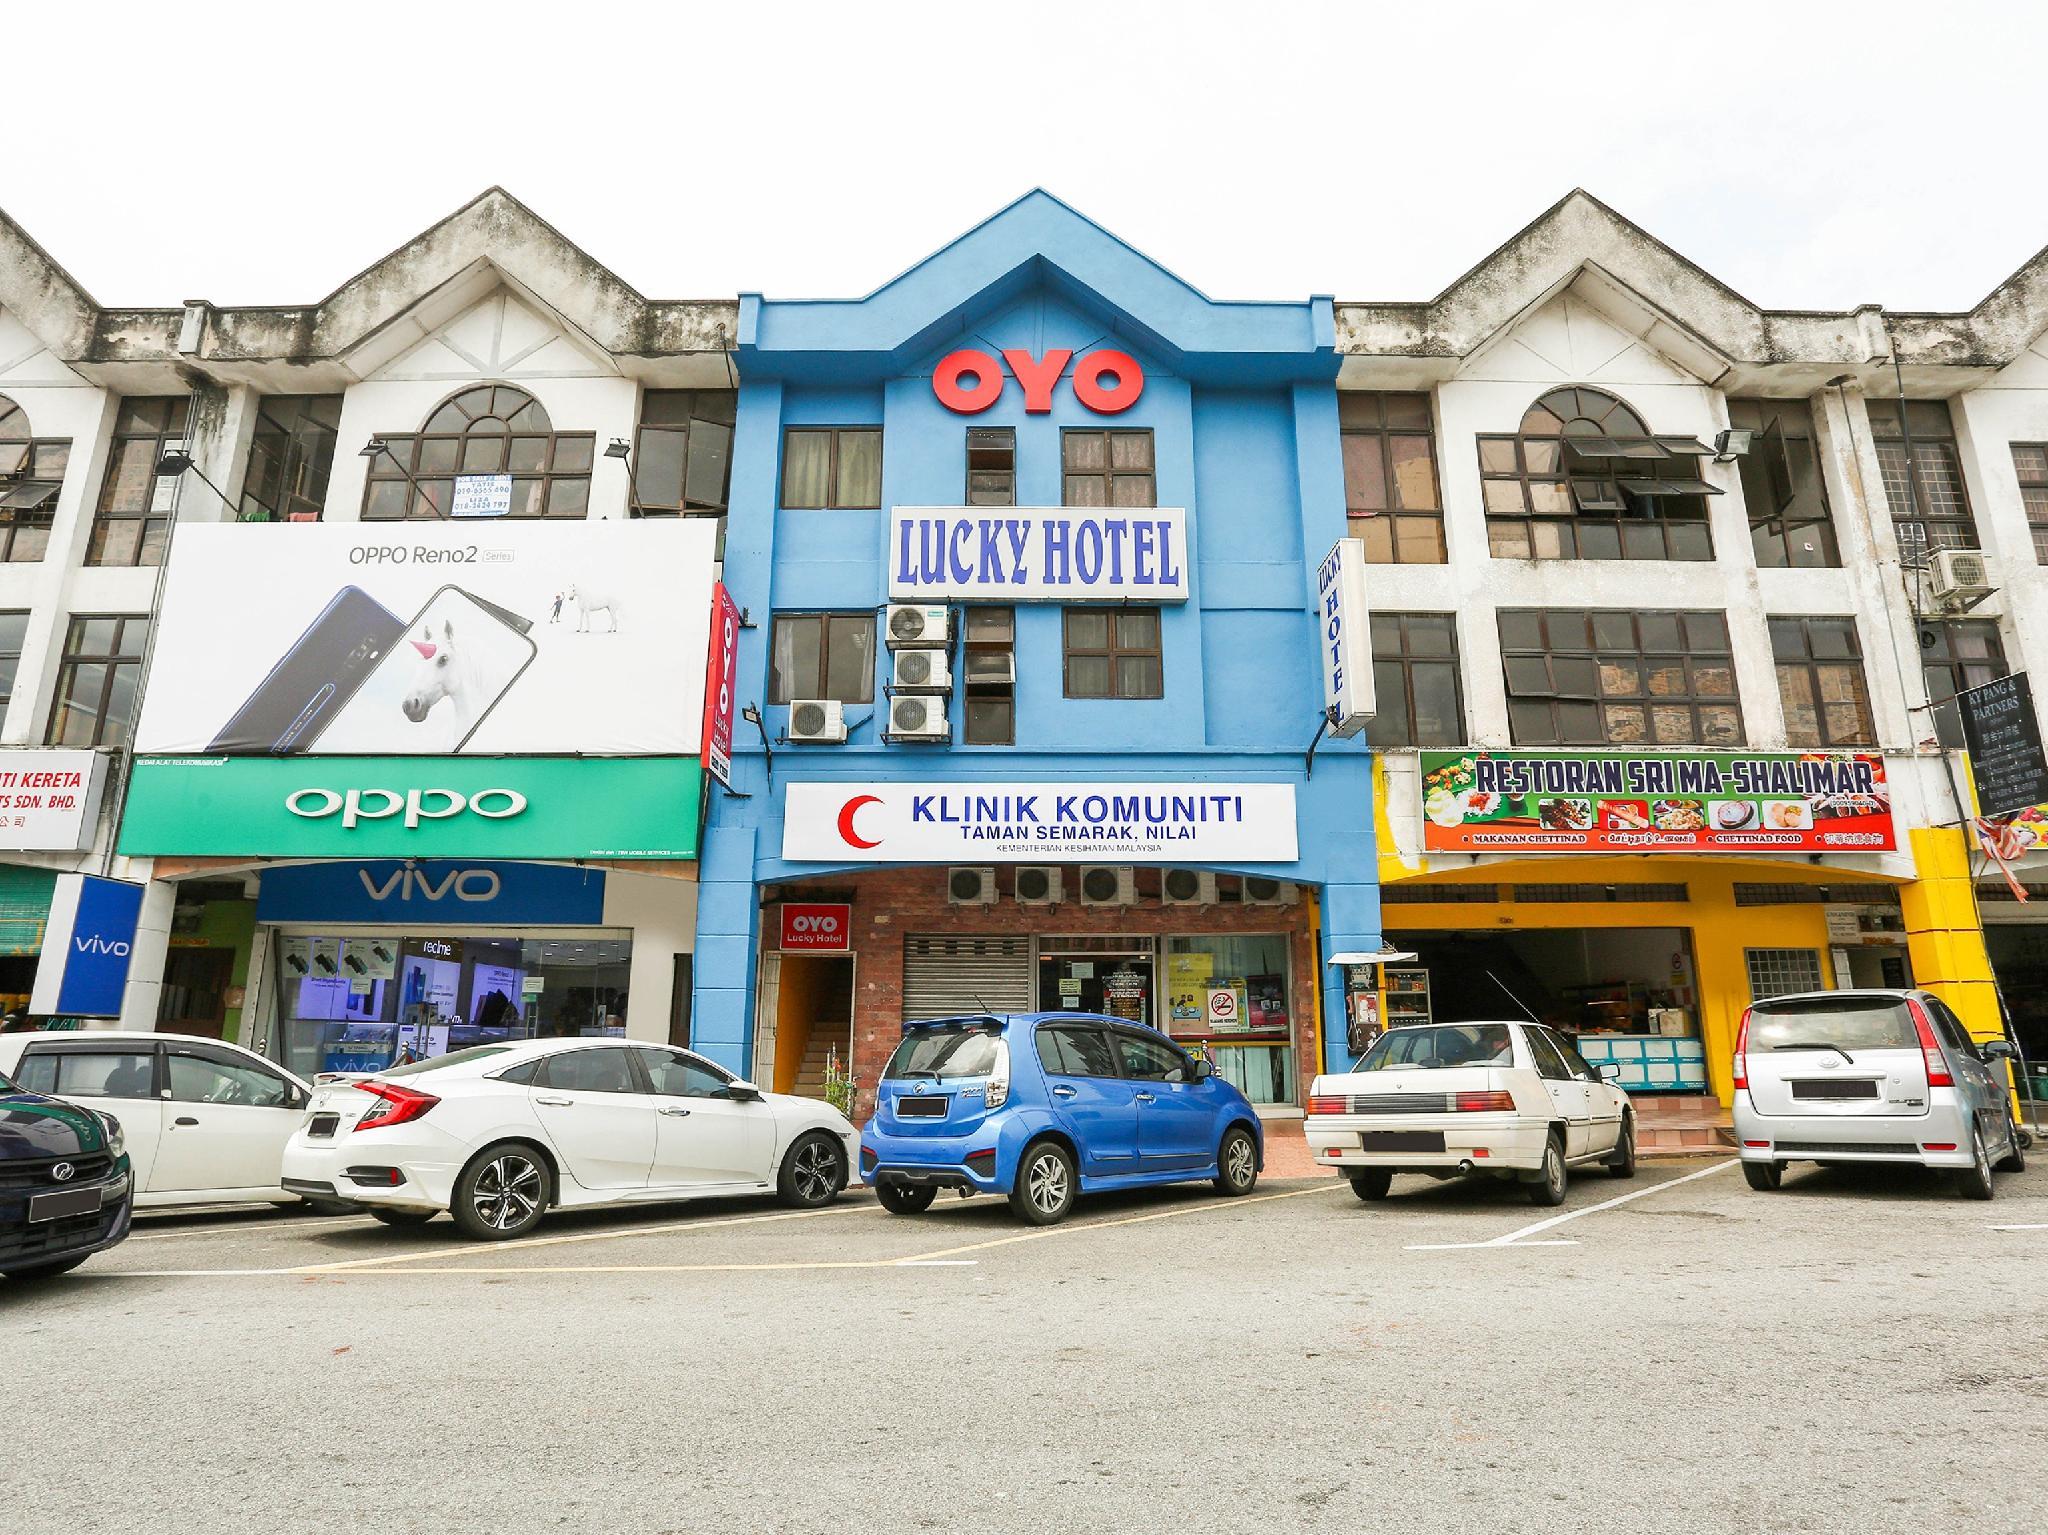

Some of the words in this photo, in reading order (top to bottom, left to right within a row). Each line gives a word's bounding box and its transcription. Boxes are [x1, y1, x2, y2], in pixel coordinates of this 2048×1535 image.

[932, 349, 1144, 415] OYO
[350, 546, 407, 564] OPPO
[412, 546, 478, 563] Reno2
[485, 551, 512, 561] Series
[897, 519, 1031, 584] LUCKY
[1043, 519, 1180, 584] HOTEL
[1319, 546, 1341, 595] LUCKY
[719, 616, 733, 715] OYO
[1968, 690, 1981, 705] KY
[1983, 682, 2007, 701] PANG
[2008, 679, 2017, 692] &
[1972, 696, 2020, 721] PARTNERS
[715, 709, 729, 739] Lucky
[0, 772, 18, 788] TI
[20, 772, 81, 788] KERETA
[1476, 760, 1624, 793] RESTORAN
[1627, 760, 1674, 794] SRI
[1679, 760, 1874, 795] MA-SHALIMAR
[14, 795, 42, 808] SDN.
[48, 795, 76, 808] BHD.
[286, 788, 528, 829] oppo
[912, 796, 1039, 823] KLINIK
[1056, 796, 1243, 824] KOMUNITI
[961, 826, 1029, 840] TAMAN
[1037, 826, 1138, 842] SEMARAK,
[1146, 826, 1196, 840] NILAI
[1474, 835, 1526, 843] MAKANAN
[1528, 835, 1586, 843] CHETTINAD
[1716, 835, 1773, 844] CHETTINAD
[1775, 835, 1801, 844] FOOD
[996, 845, 1062, 853] KEMENTERIAN
[1064, 845, 1115, 853] KESIHATAN
[1116, 845, 1162, 853] MALAYSIA
[359, 859, 501, 903] vivo
[793, 916, 838, 933] OYO
[75, 934, 130, 957] vivo
[423, 940, 452, 956] realme
[787, 934, 815, 944] Lucky
[816, 934, 842, 943] Hotel
[335, 1059, 381, 1073] vivo
